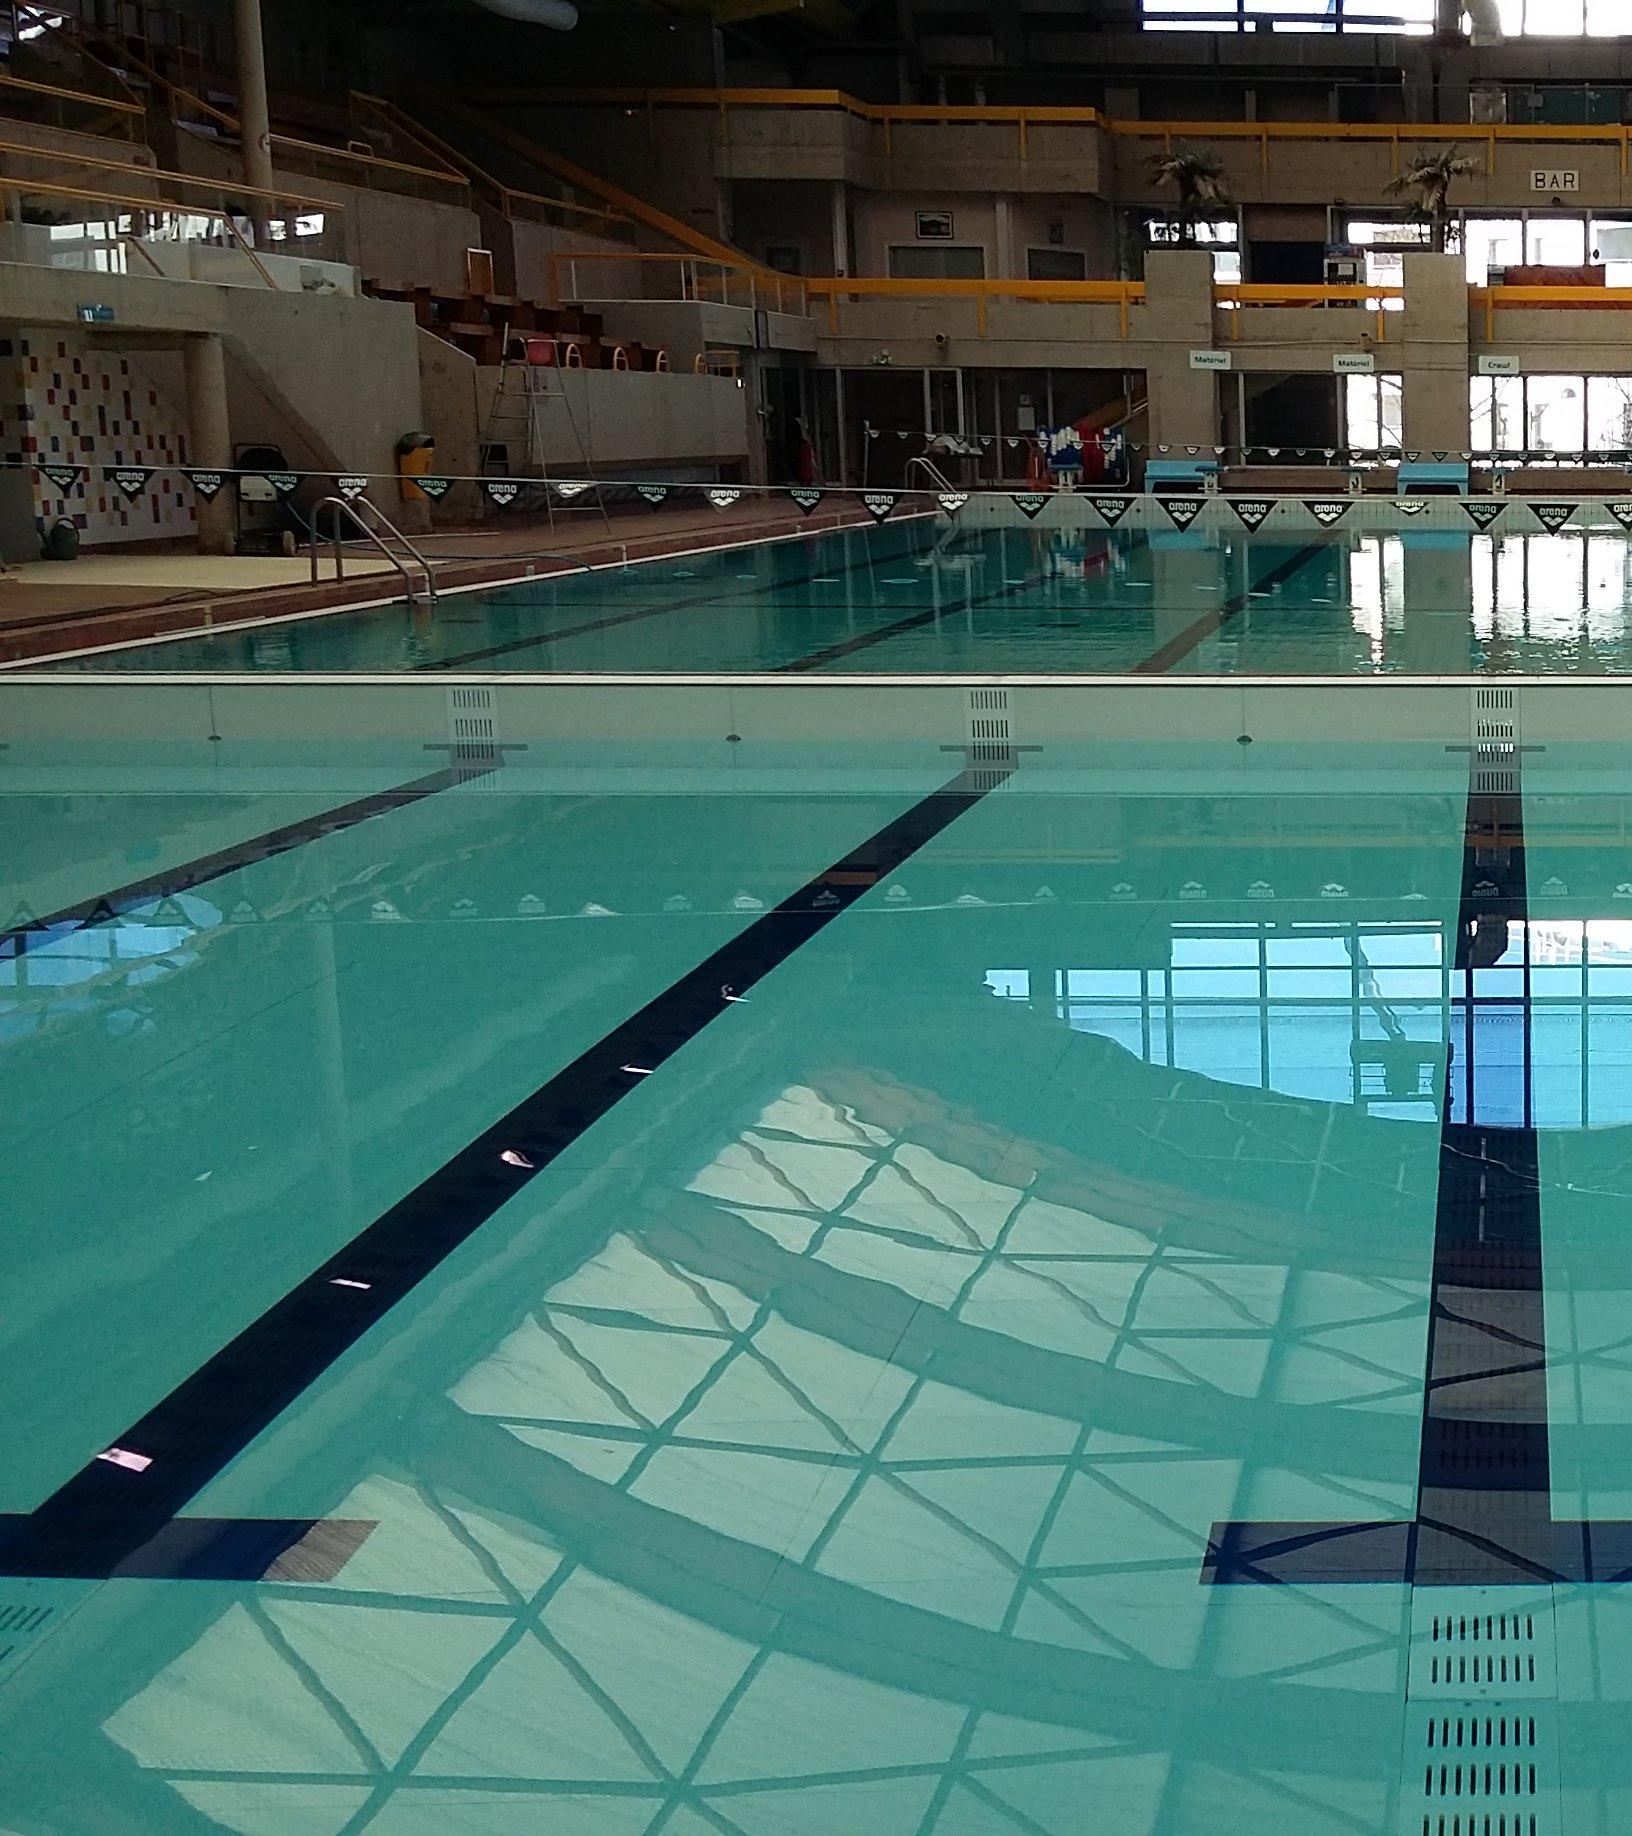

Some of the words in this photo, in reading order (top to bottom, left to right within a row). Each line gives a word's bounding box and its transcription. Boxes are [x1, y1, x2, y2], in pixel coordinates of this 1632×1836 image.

[1535, 172, 1575, 189] BAR
[193, 474, 221, 484] arena
[268, 474, 297, 484] arena
[338, 478, 366, 487] arena
[417, 478, 447, 488] arena
[488, 483, 517, 493] arena
[637, 485, 667, 494] arena
[711, 489, 740, 498] arena
[791, 489, 820, 498] arena
[939, 493, 968, 502] arena
[1015, 494, 1044, 503] arena
[865, 494, 893, 504] arena
[1096, 499, 1124, 509] arena
[1168, 501, 1197, 512] arena
[1238, 503, 1267, 513] arena
[1314, 503, 1343, 513] arena
[1469, 504, 1497, 514] arena
[1539, 506, 1568, 517] arena
